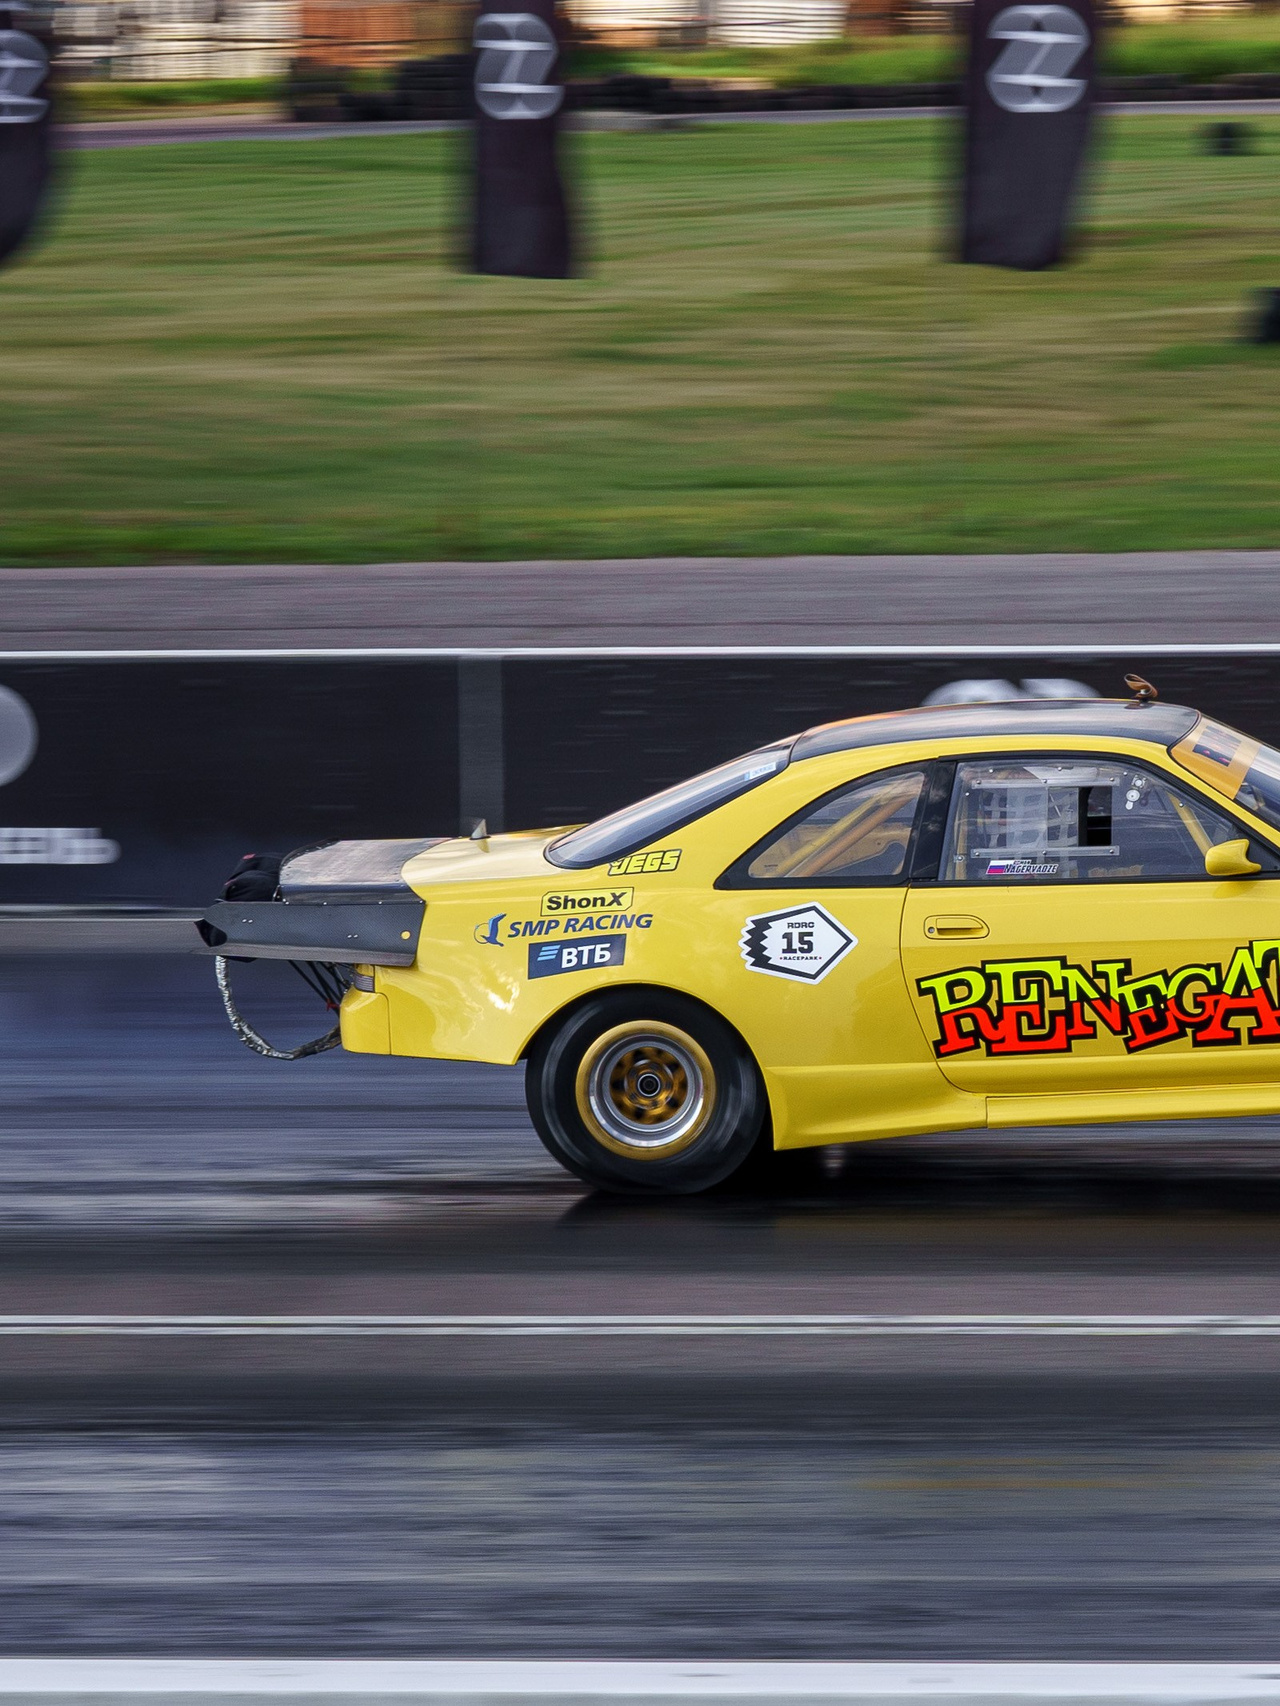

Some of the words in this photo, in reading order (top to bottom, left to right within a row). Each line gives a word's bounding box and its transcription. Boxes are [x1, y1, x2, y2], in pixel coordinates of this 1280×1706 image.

[608, 849, 682, 876] JEGS
[547, 892, 627, 911] ShonX
[508, 919, 560, 938] SMP
[563, 914, 653, 933] RACING
[787, 921, 815, 929] RDRC
[781, 931, 814, 954] 15
[561, 943, 612, 969] ВТБ
